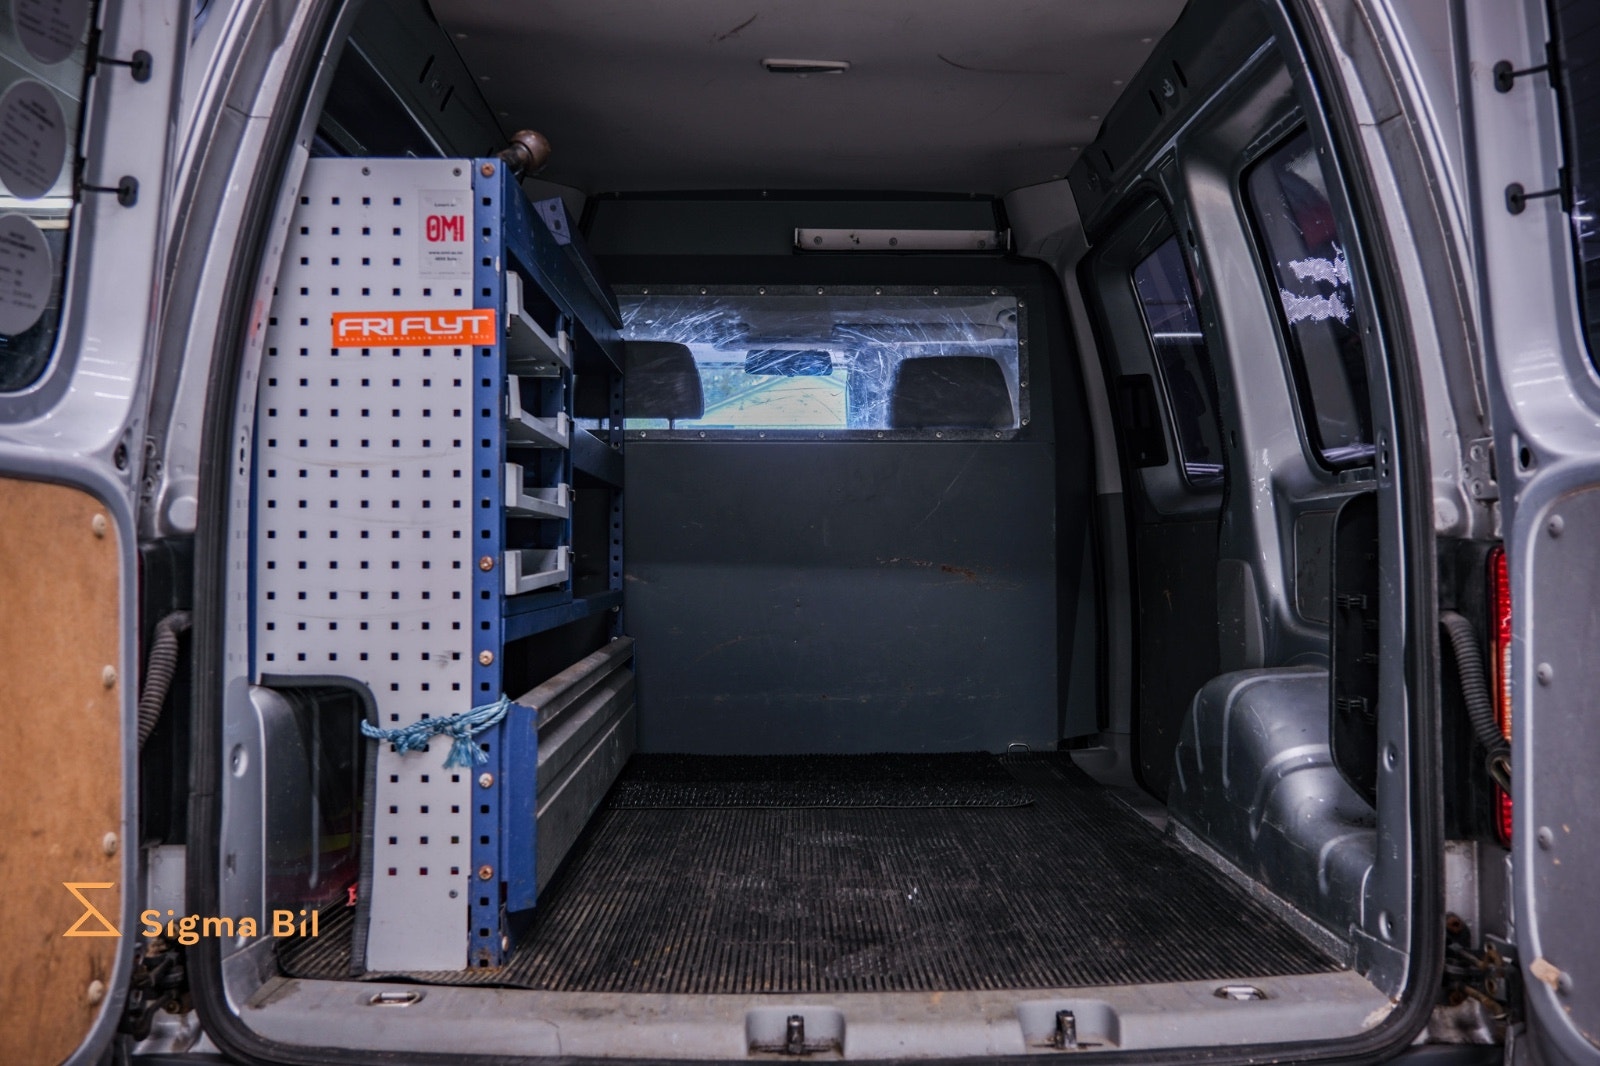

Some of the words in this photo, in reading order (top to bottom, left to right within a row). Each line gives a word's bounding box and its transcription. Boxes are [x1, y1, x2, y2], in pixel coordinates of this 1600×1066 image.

[426, 214, 465, 242] OMI
[338, 317, 394, 336] FRI
[401, 315, 489, 335] FLYT
